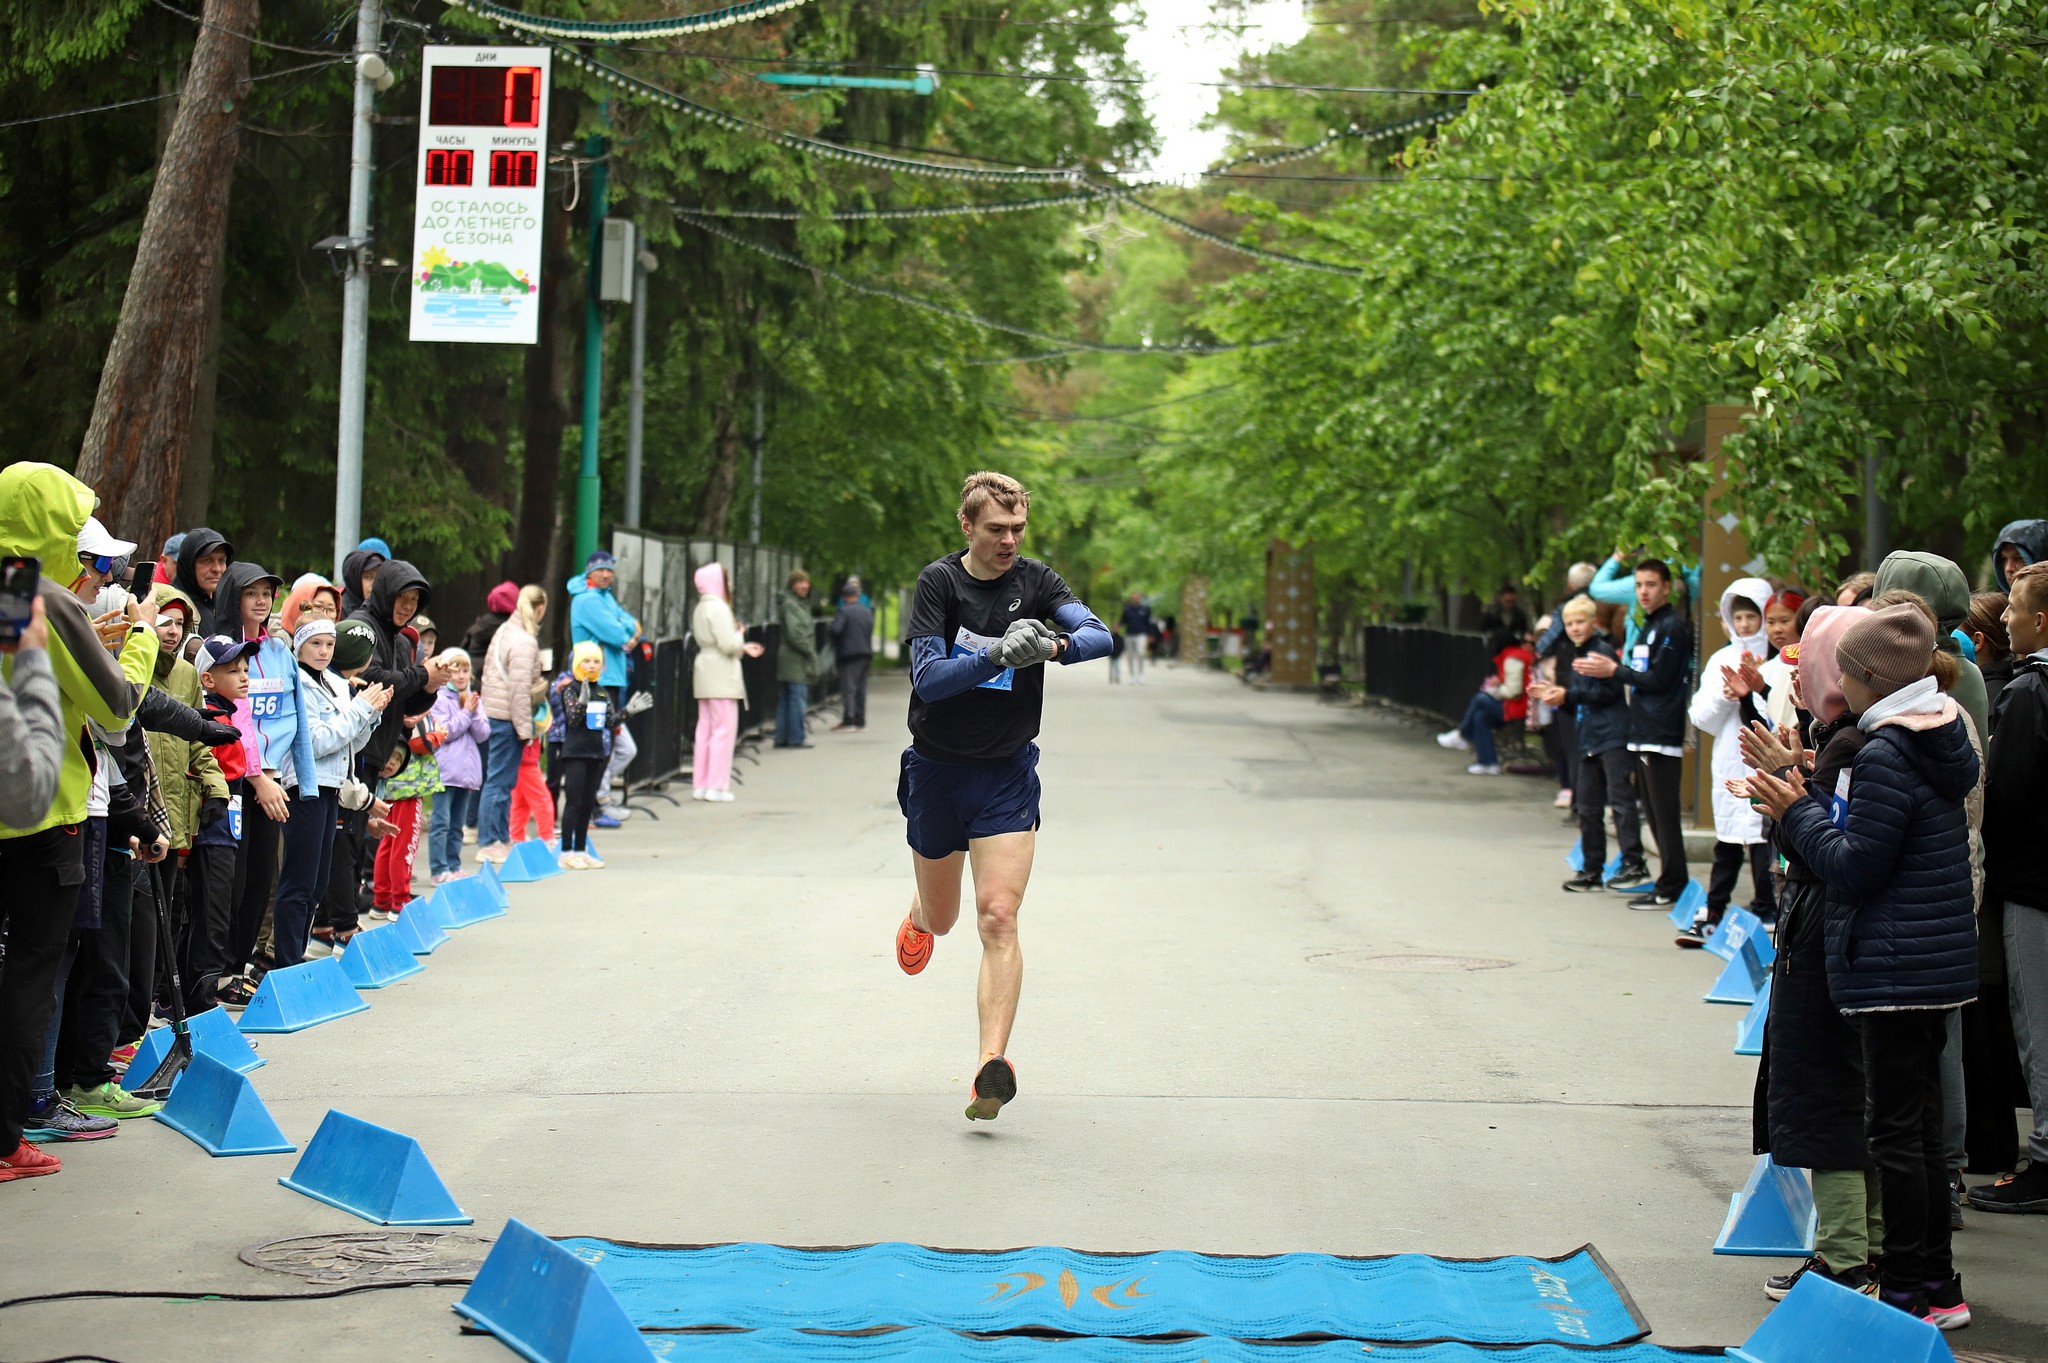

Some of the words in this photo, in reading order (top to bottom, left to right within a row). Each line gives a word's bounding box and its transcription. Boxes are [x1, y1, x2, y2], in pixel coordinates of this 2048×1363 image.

[475, 52, 497, 62] ДНИ
[504, 65, 542, 129] 0
[436, 136, 465, 145] ЧАСЫ
[491, 137, 537, 146] МИНУТЫ
[426, 150, 473, 187] 00
[490, 151, 537, 188] 00
[431, 201, 528, 215] ОСТАЛОСЬ
[421, 216, 449, 229] ДО
[455, 217, 536, 230] ЛЕТНЕГО
[443, 232, 513, 245] СЕЗОНА
[91, 830, 101, 918] overcome
